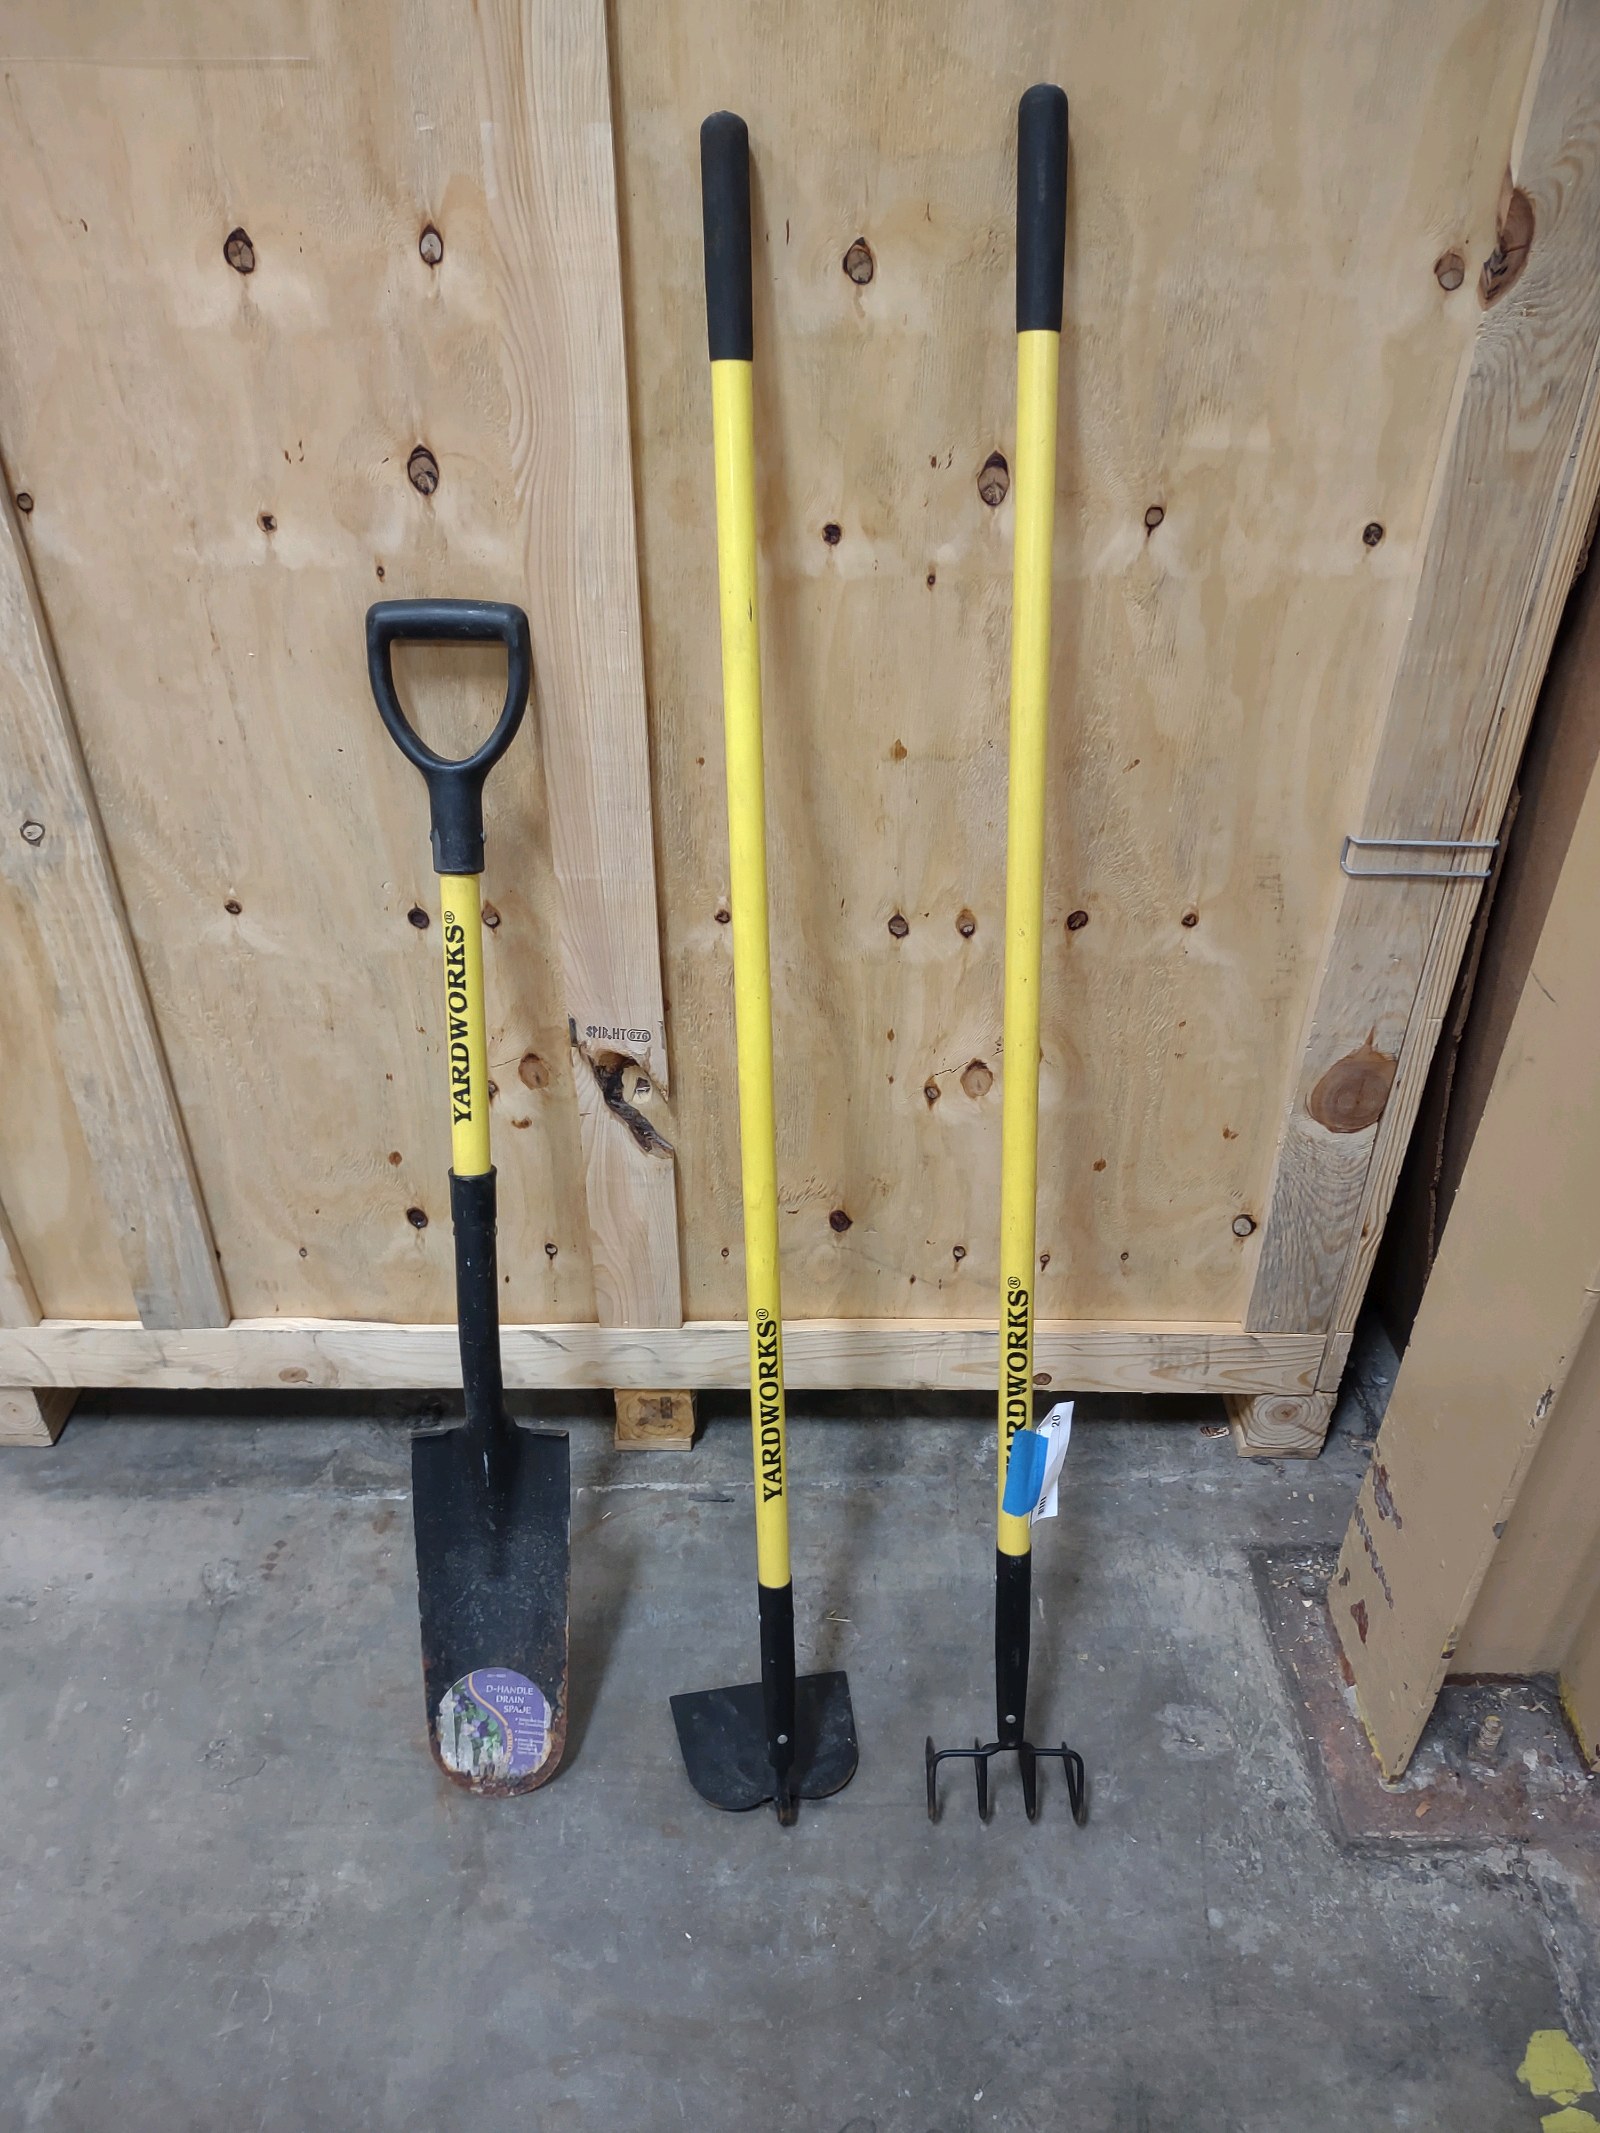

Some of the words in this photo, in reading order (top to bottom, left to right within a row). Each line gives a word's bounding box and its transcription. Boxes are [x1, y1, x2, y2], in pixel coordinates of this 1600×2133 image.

[629, 1031, 649, 1040] 676
[1007, 1276, 1029, 1475] RDWORKS®
[1051, 1414, 1061, 1428] 20
[486, 1684, 534, 1696] D-HANDLE
[495, 1694, 525, 1704] DRAIN
